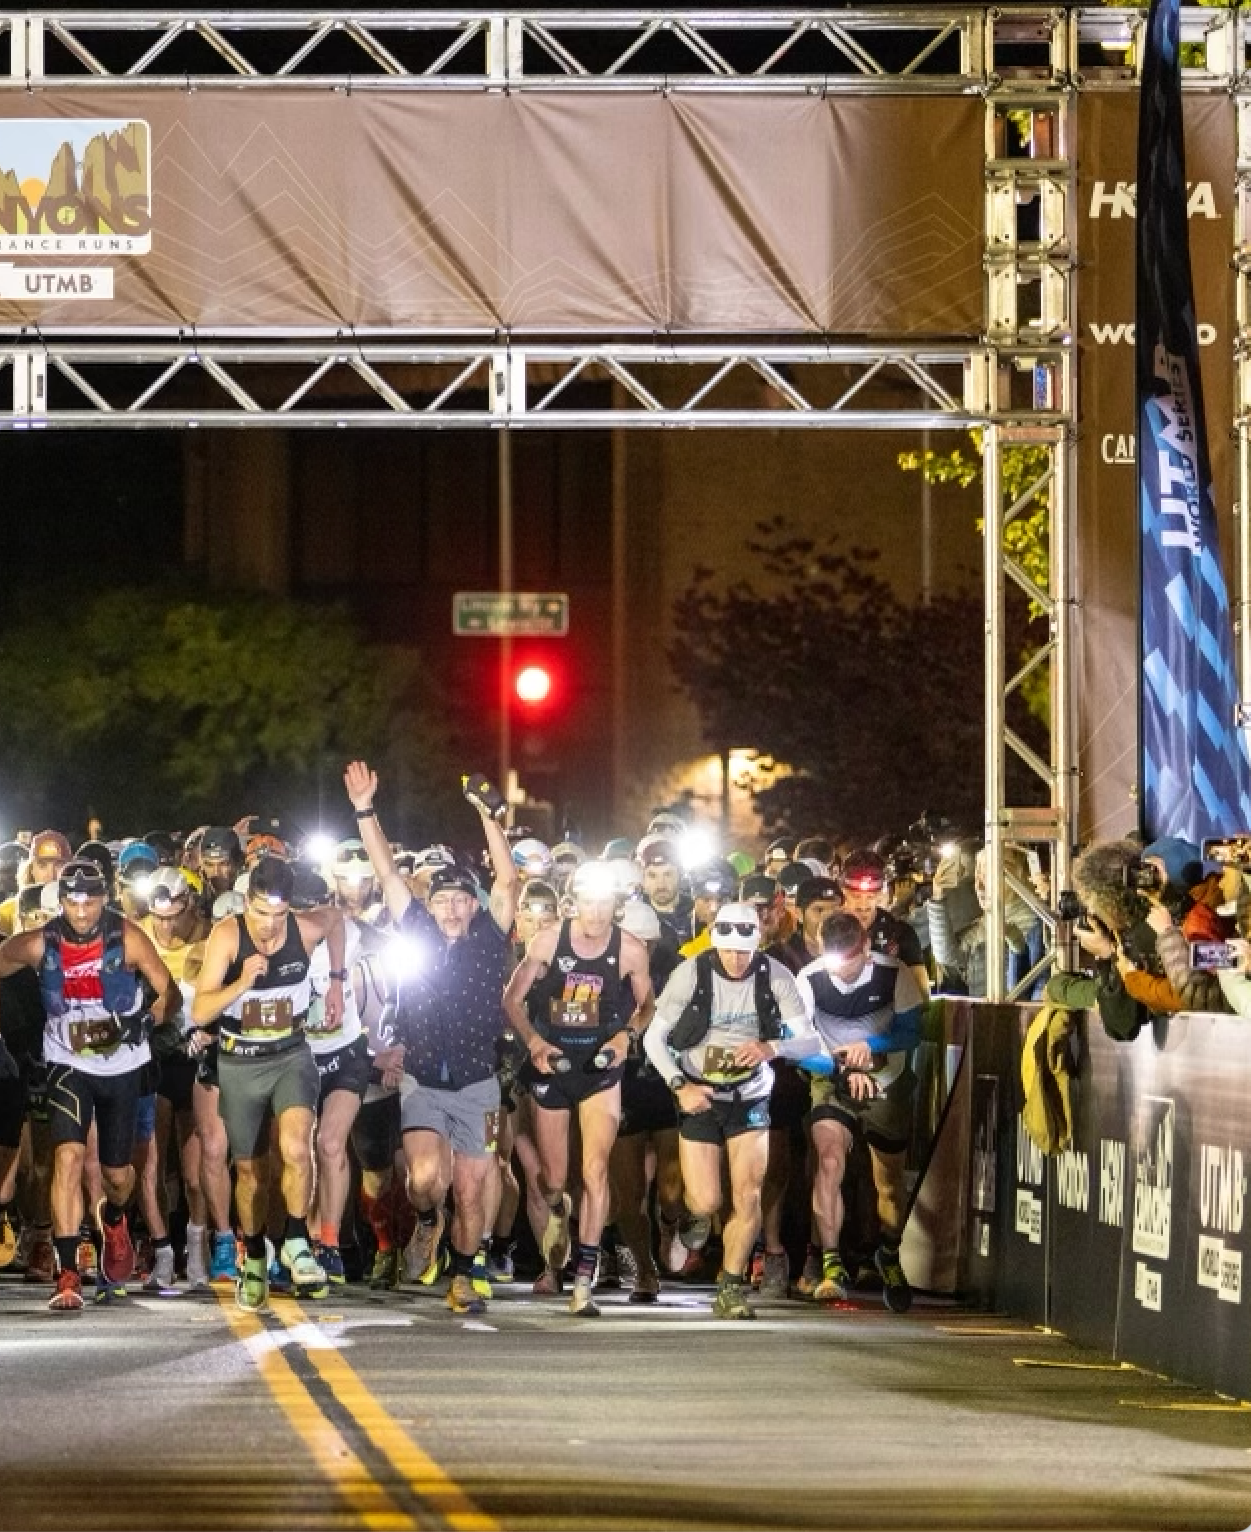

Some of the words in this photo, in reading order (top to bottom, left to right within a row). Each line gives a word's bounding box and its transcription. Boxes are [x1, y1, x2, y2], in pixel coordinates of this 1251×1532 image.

[79, 239, 134, 251] RUNS
[25, 274, 93, 293] UTMB
[1200, 1142, 1244, 1234] UTMB
